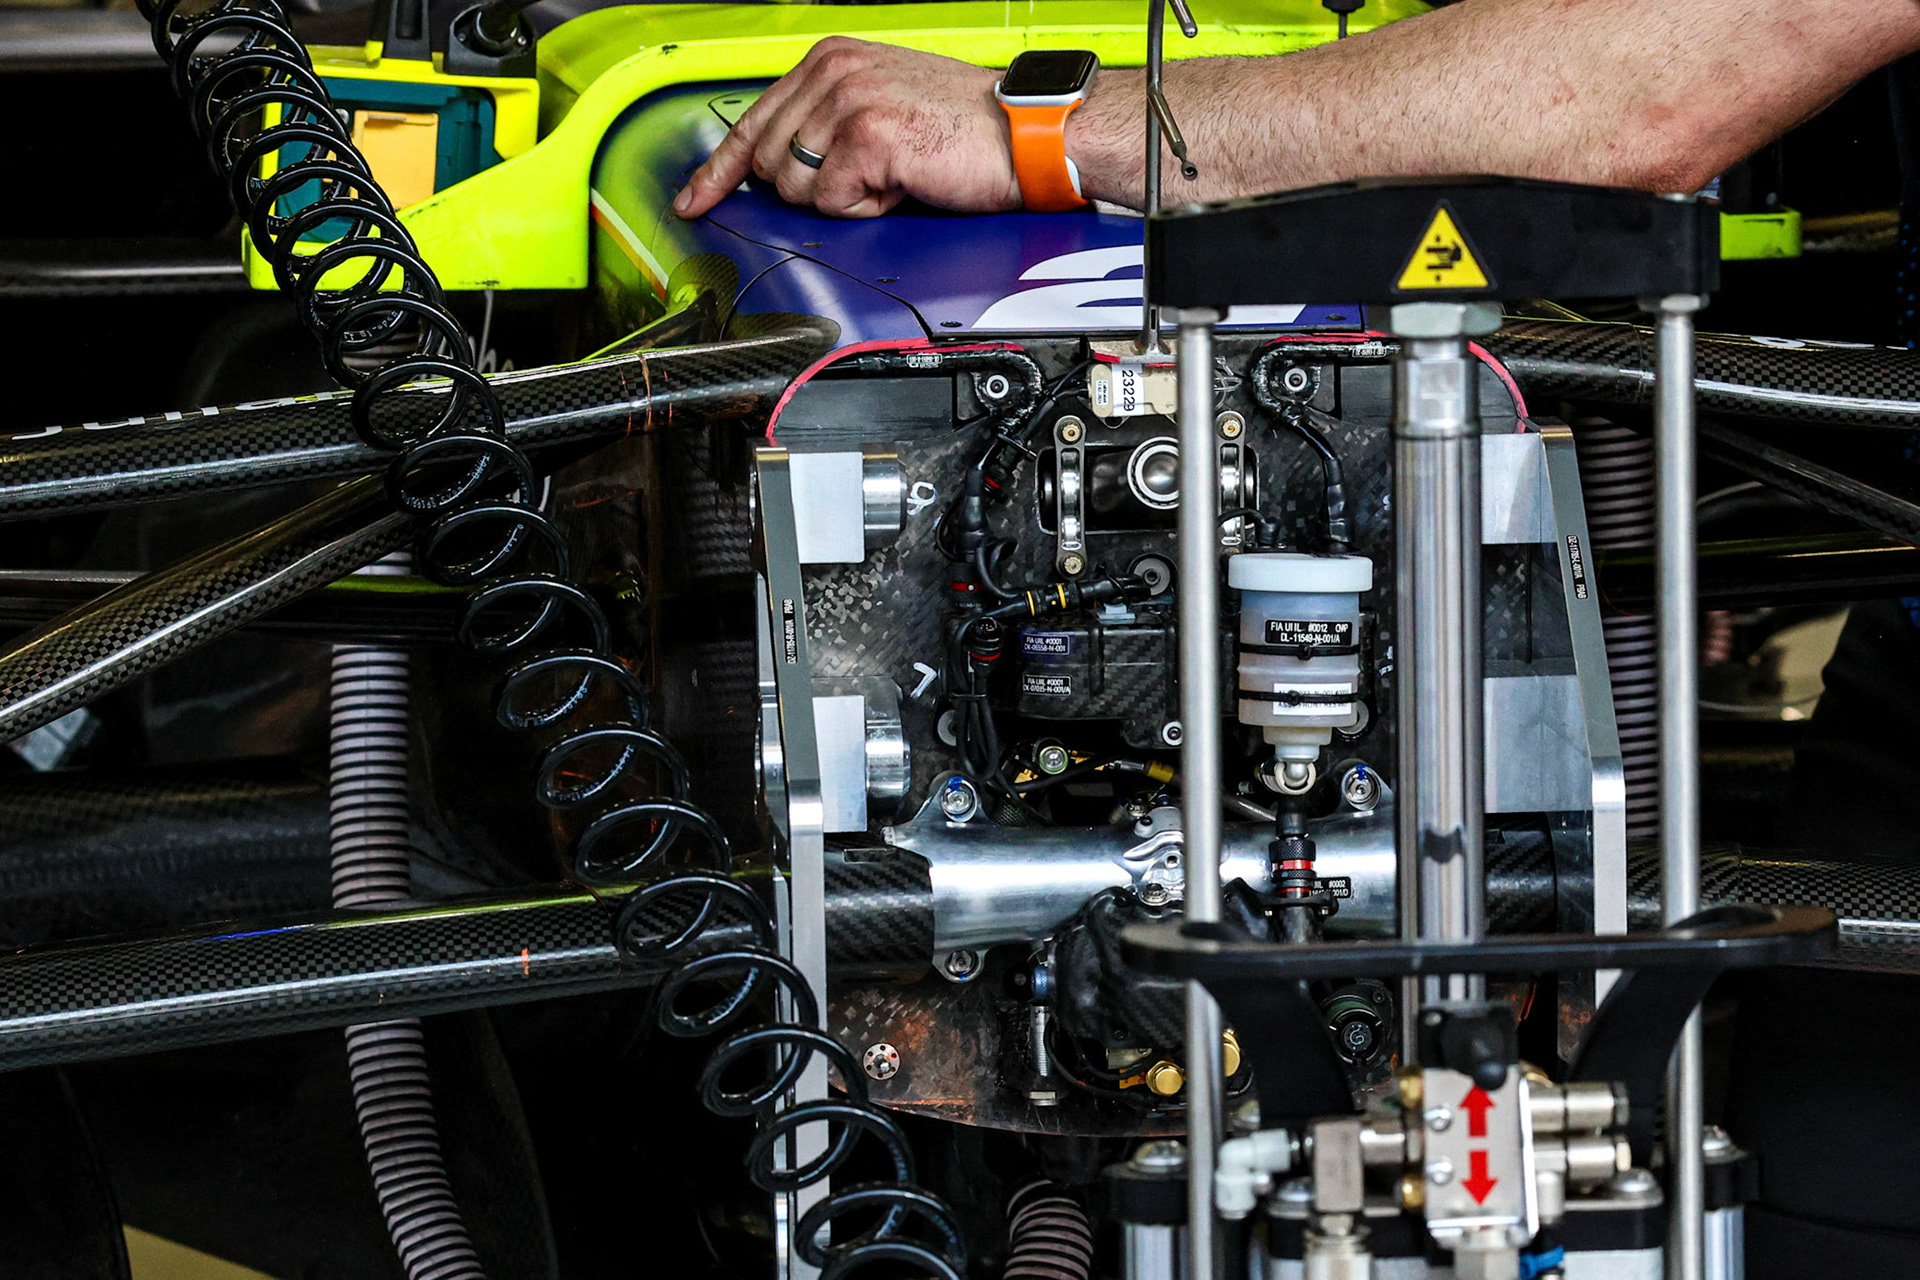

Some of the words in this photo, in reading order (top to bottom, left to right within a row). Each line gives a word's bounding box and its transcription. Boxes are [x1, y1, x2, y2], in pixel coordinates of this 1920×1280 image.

[1121, 369, 1136, 412] 23229
[1270, 622, 1284, 631] FIA
[1308, 623, 1328, 633] #0012
[910, 661, 938, 698] 7
